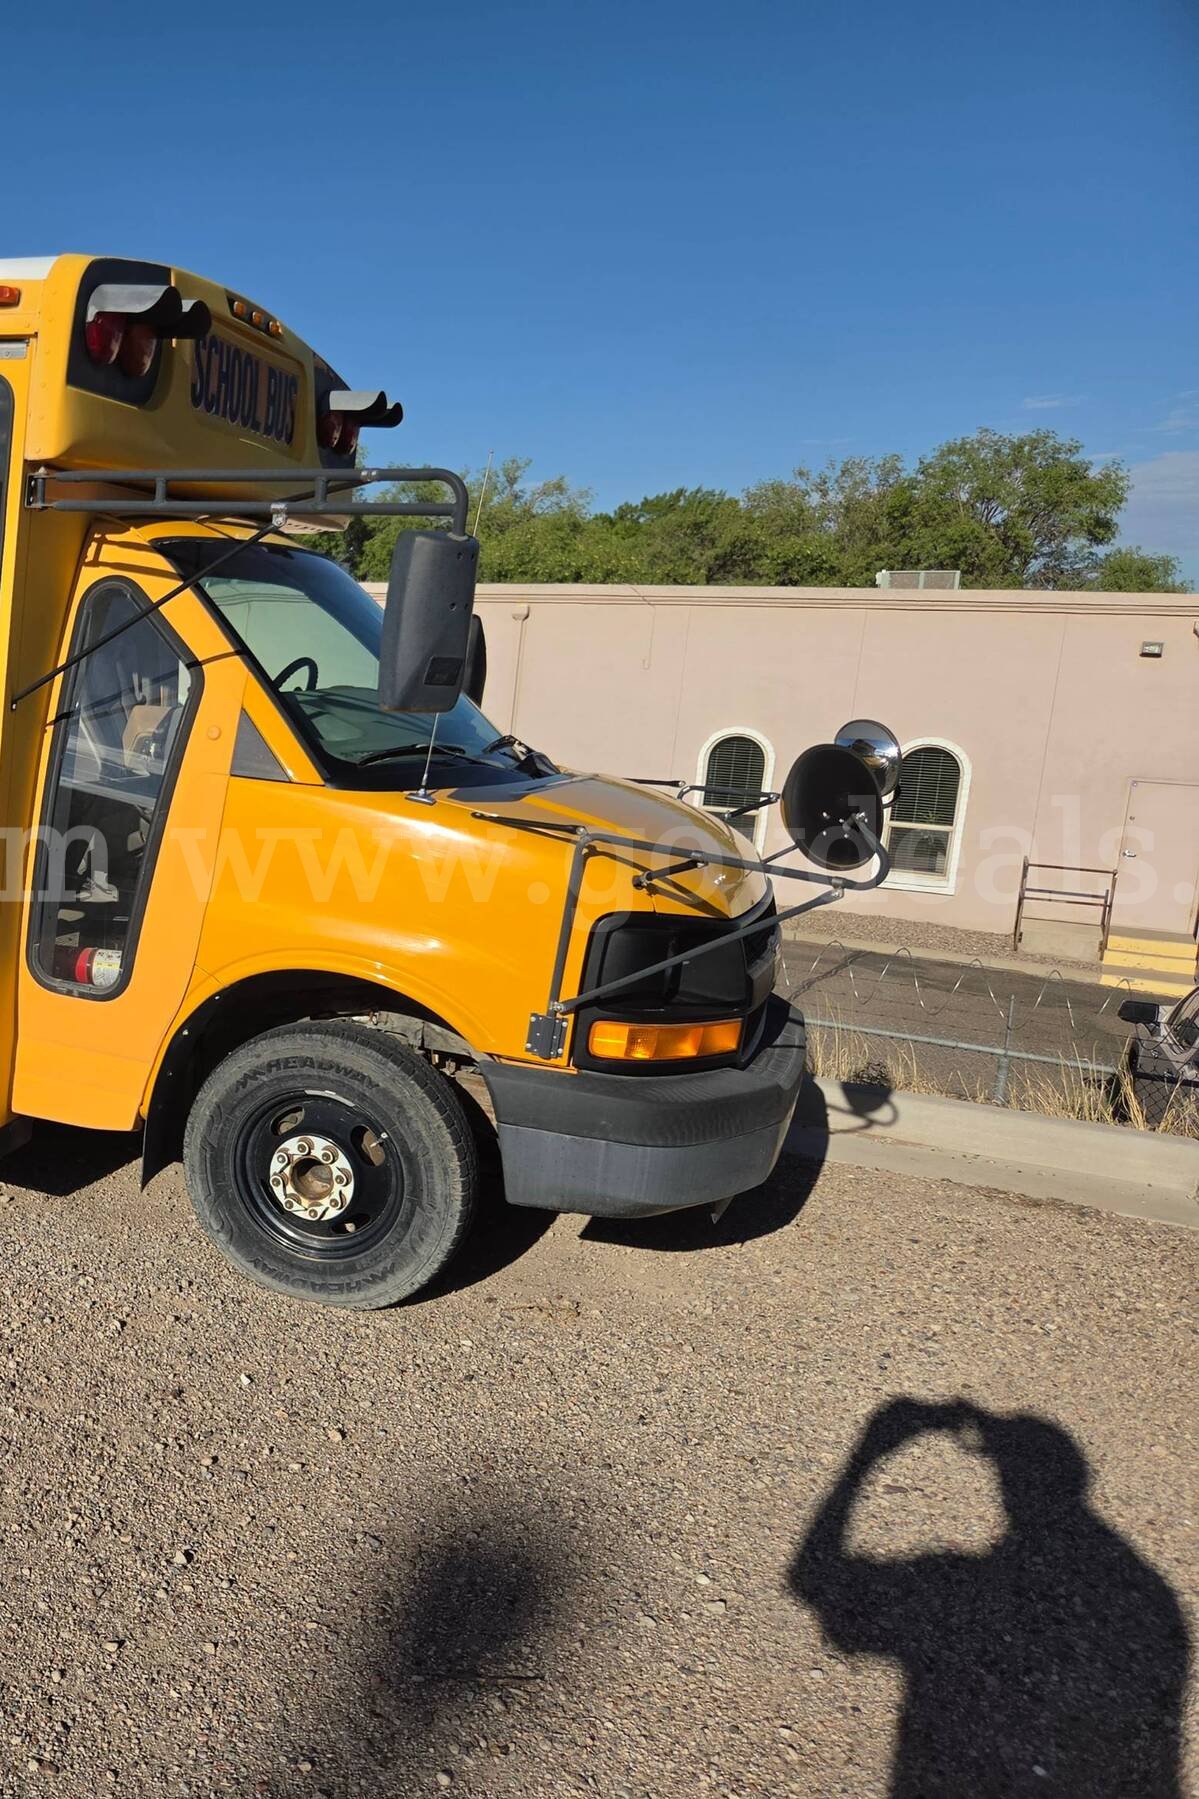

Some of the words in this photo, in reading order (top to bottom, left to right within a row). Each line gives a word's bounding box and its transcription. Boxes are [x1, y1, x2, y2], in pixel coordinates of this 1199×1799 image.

[191, 334, 261, 434] SCHOOL
[263, 365, 298, 446] BUS
[266, 1055, 380, 1090] HEADWAY
